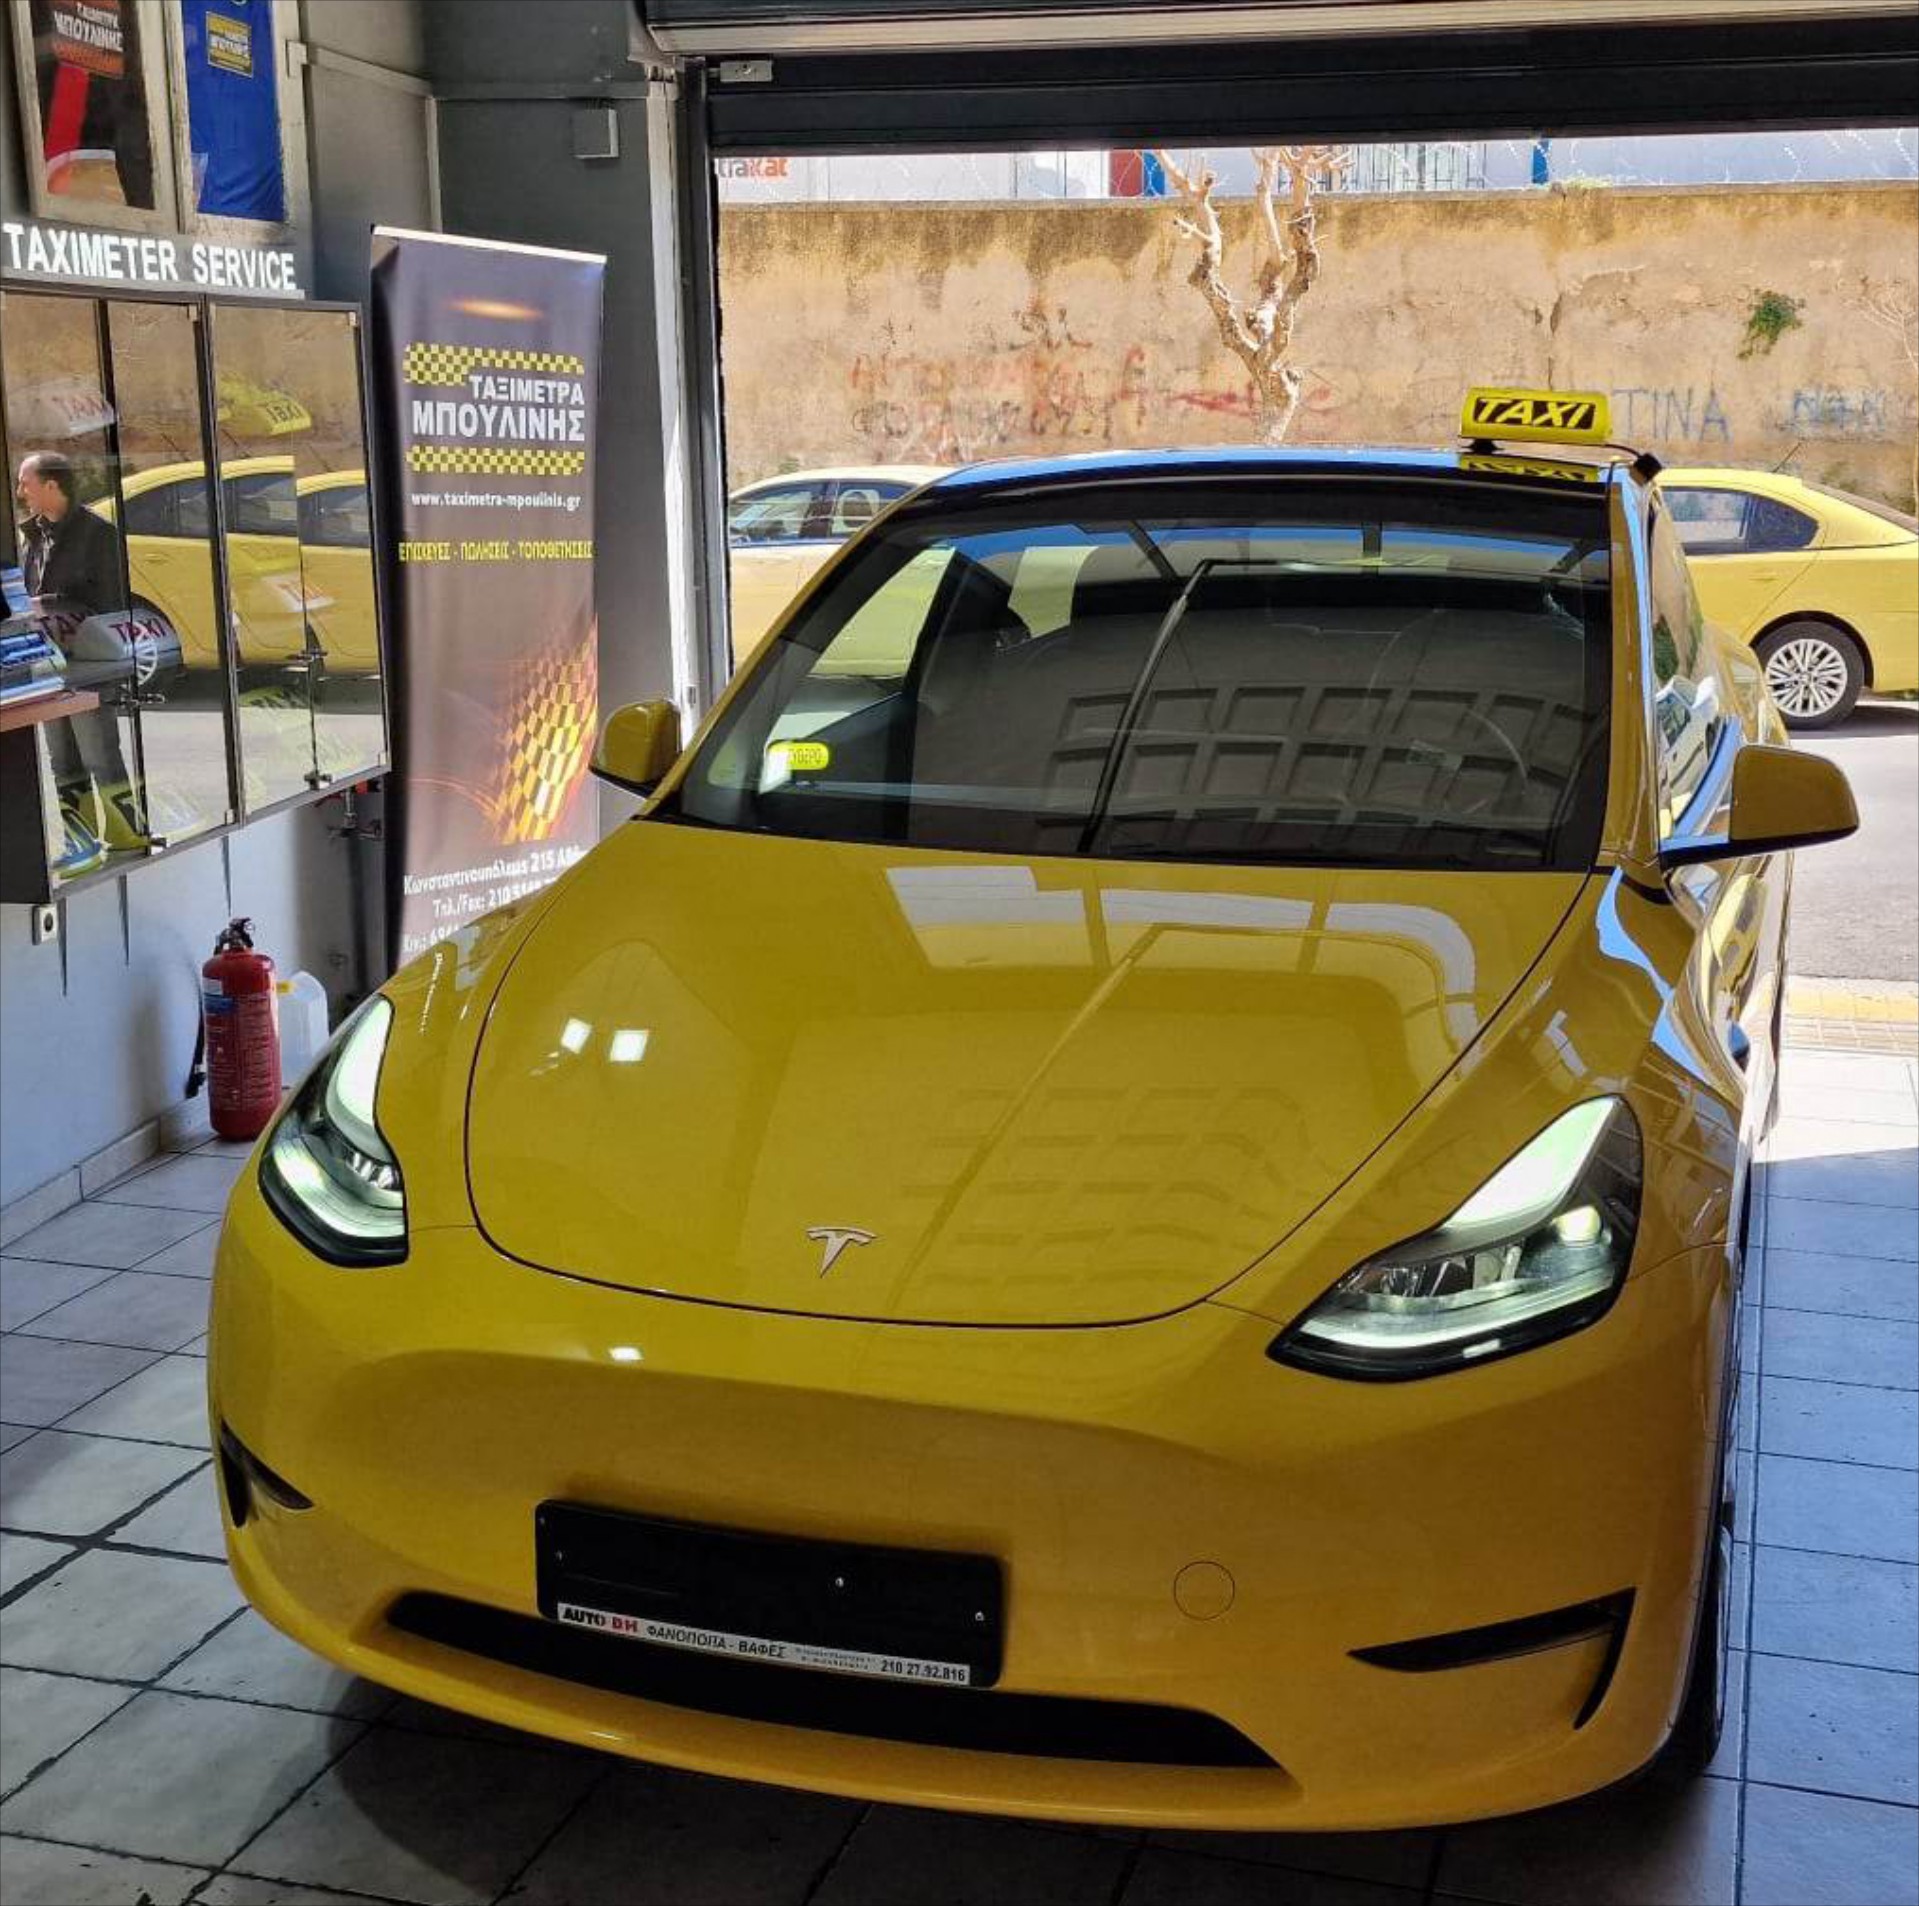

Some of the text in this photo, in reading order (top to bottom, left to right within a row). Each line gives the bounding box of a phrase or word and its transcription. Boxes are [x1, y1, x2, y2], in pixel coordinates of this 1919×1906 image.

[3, 222, 297, 289] TAXIMETER SERVICE
[469, 375, 585, 405] ΤΑΞΙΜΕΤΡΑ
[412, 401, 585, 441] ΜΠΟΥΛΙΝΗΣ
[1478, 398, 1591, 428] TAXI
[530, 850, 555, 873] 215
[563, 1606, 606, 1628] AUTO
[739, 1640, 787, 1659] ΒΑΦΕΣ
